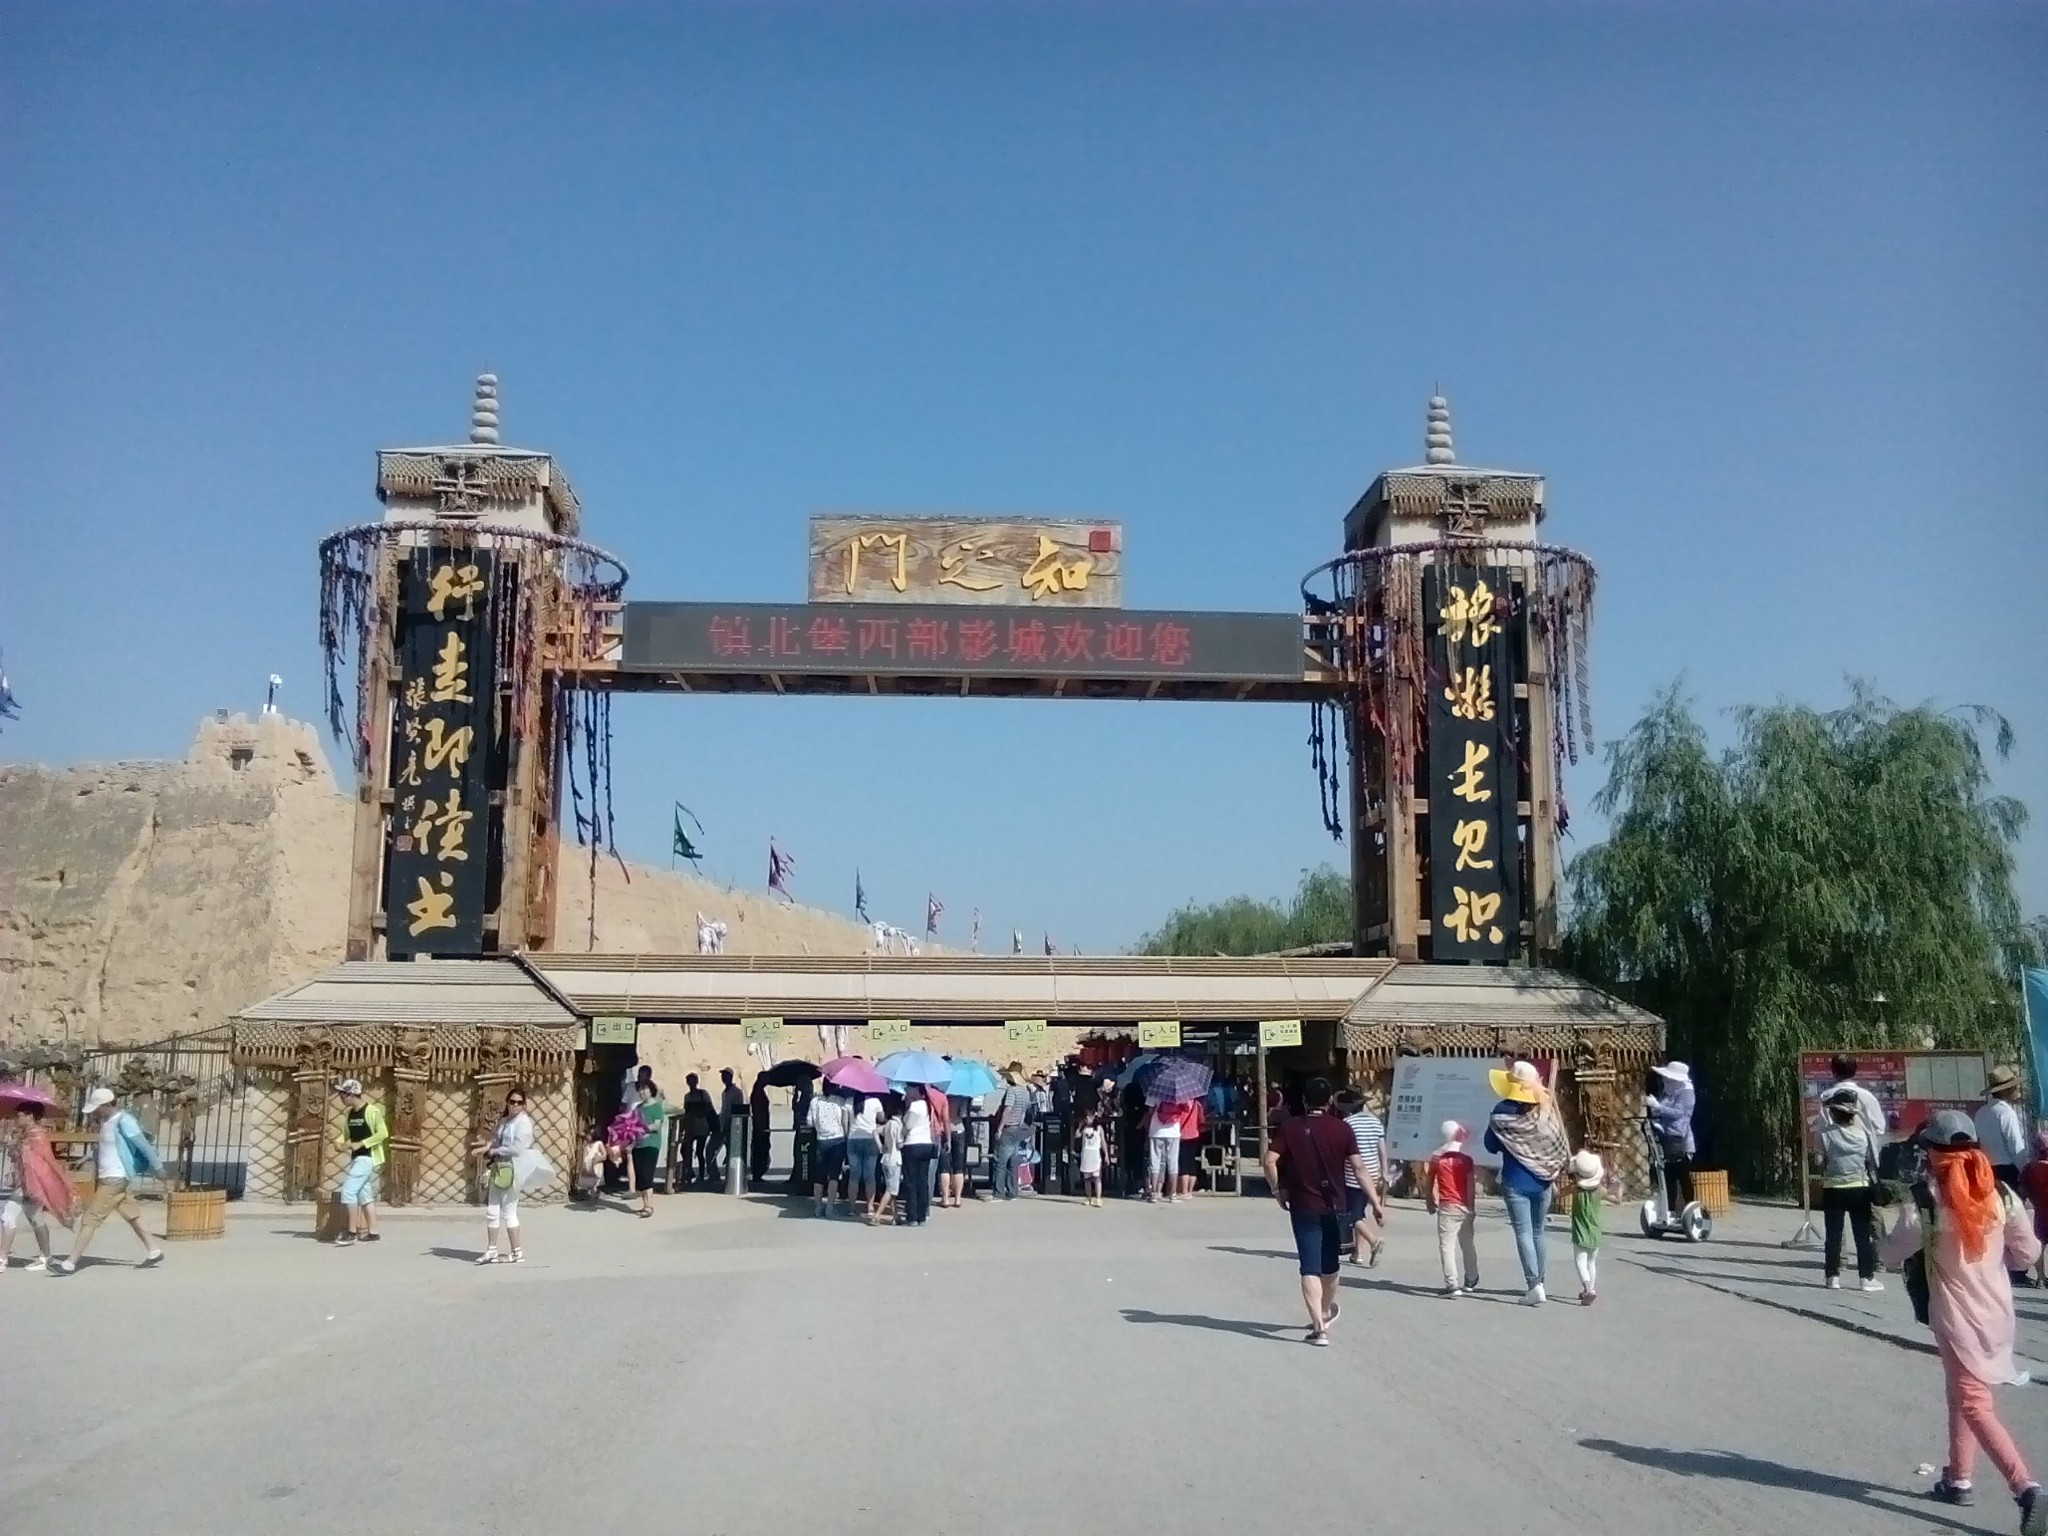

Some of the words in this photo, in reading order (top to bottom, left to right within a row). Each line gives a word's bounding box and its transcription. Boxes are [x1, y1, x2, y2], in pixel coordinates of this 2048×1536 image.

[708, 614, 1191, 666] 镇北堡西部影城欢迎您
[612, 1021, 633, 1031] 出口
[761, 1021, 780, 1029] 入口
[888, 1024, 907, 1032] 入口
[1024, 1024, 1044, 1033] 入口
[1158, 1025, 1177, 1034] 入口
